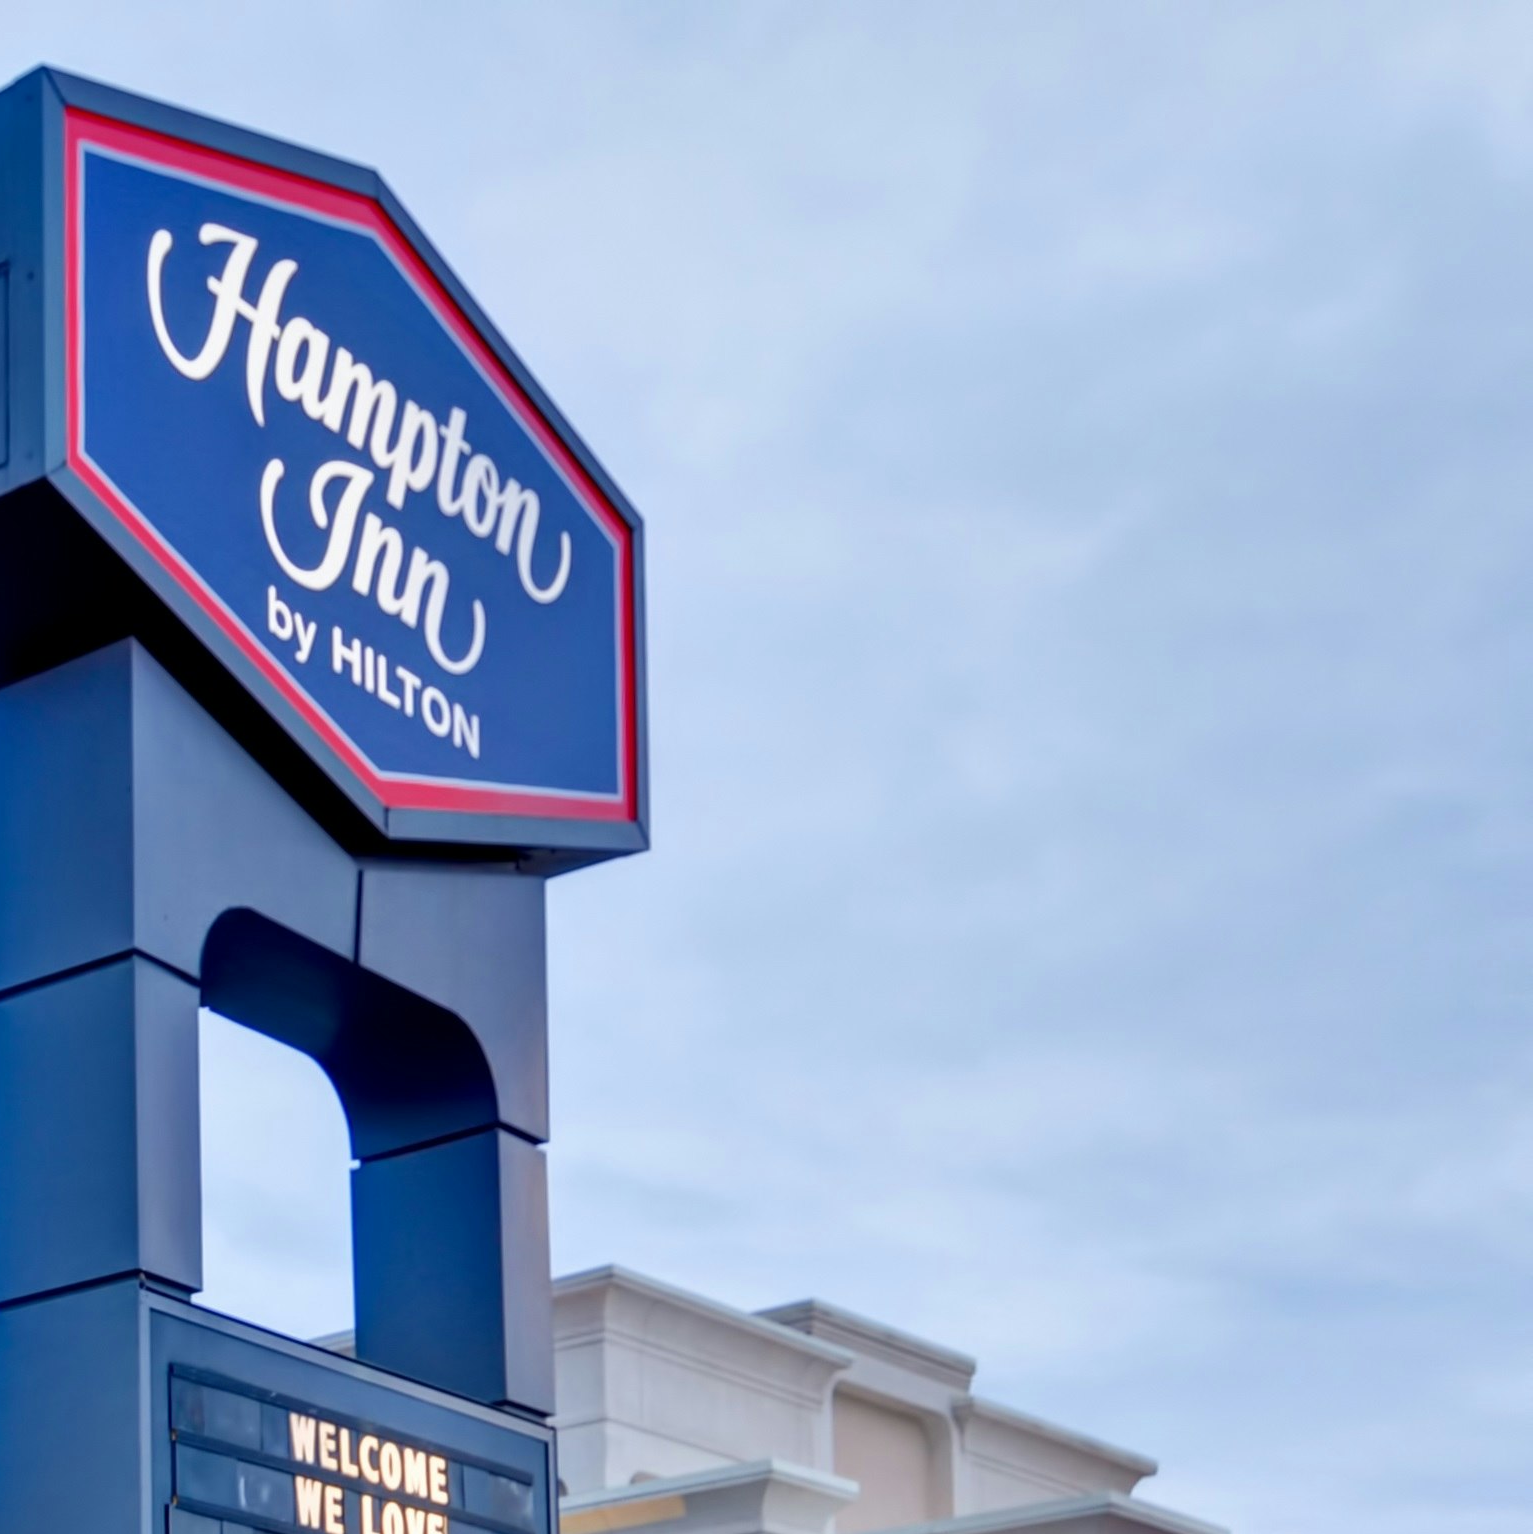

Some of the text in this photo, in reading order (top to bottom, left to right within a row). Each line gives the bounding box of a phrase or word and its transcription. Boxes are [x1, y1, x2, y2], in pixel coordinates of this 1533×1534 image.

[147, 222, 571, 605] Hampton
[260, 459, 486, 676] Inn
[267, 585, 481, 760] by HILTON
[289, 1412, 449, 1505] WELCOME
